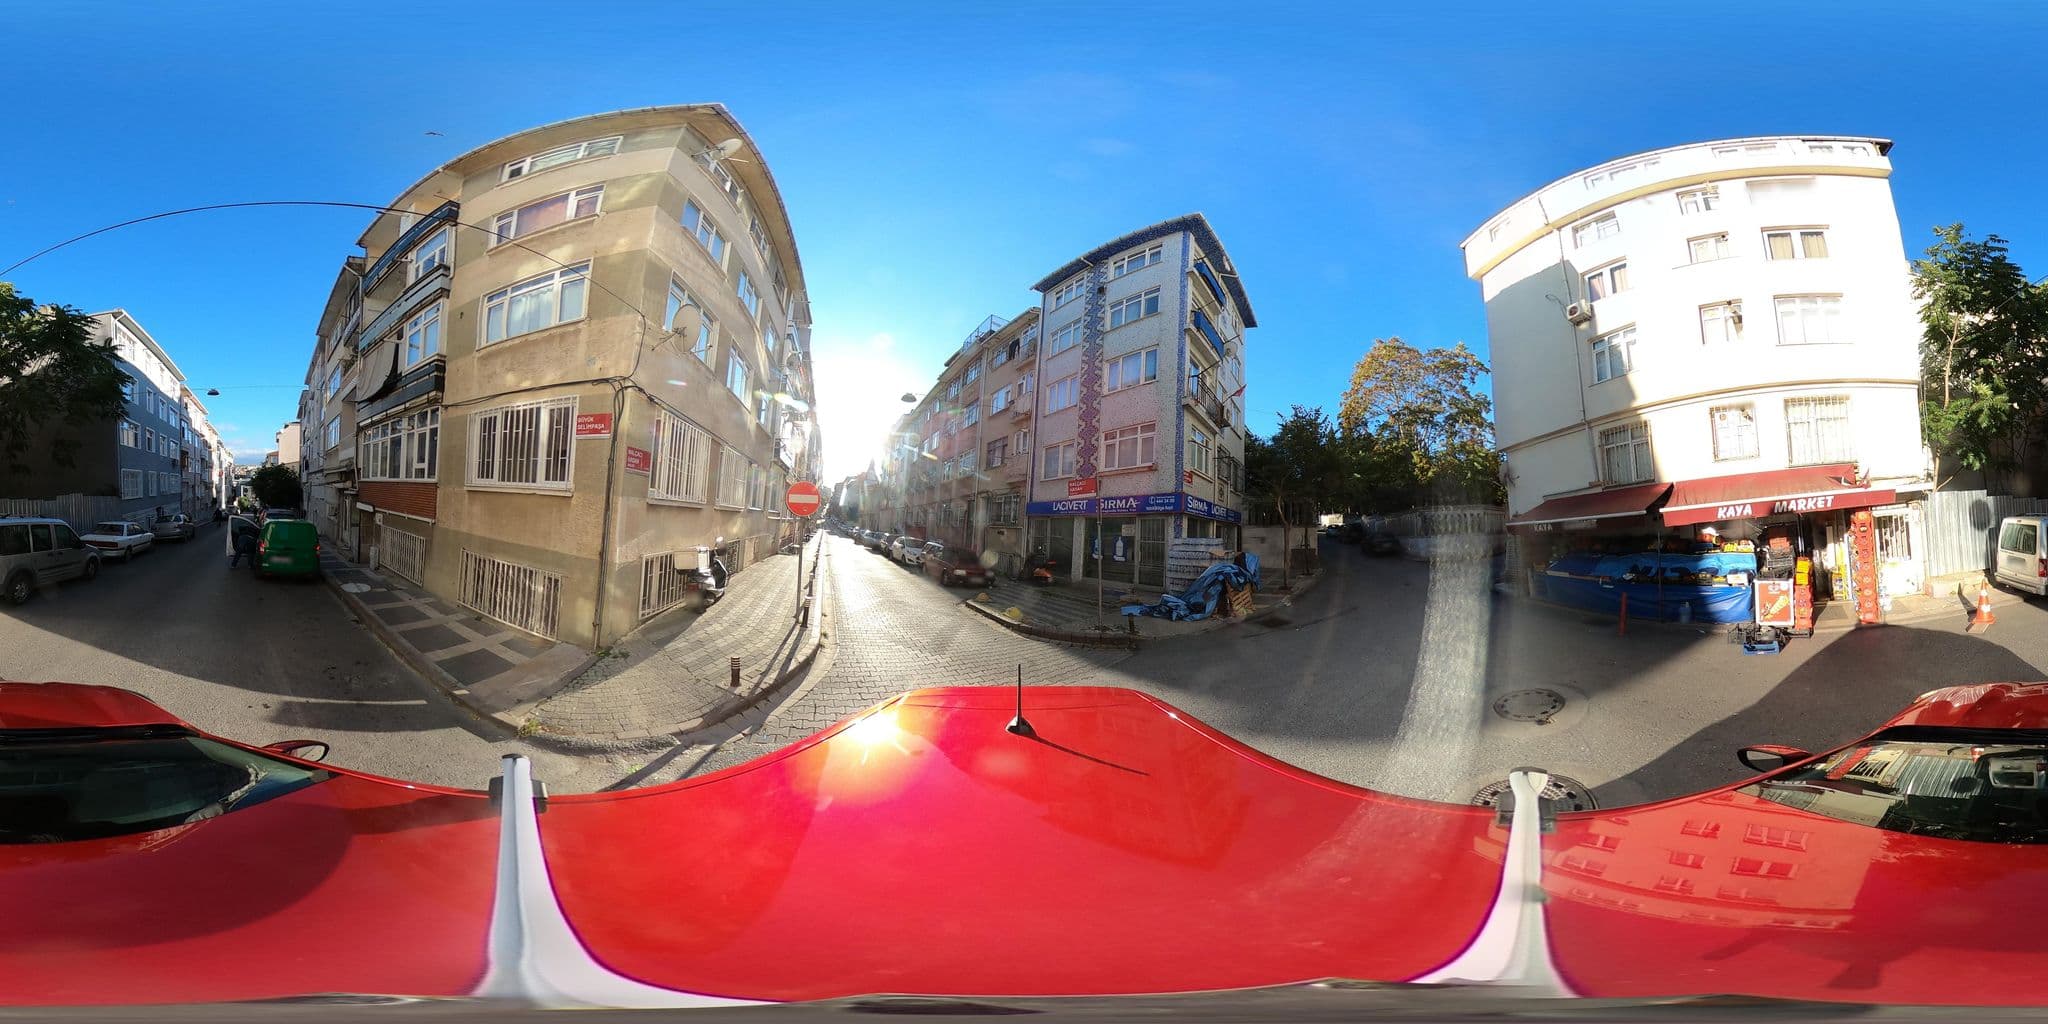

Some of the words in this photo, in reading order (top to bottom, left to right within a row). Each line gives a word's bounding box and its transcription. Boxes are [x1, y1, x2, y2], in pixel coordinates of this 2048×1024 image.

[1187, 496, 1208, 512] SIRMA
[1717, 504, 1752, 519] KAYA
[1774, 496, 1834, 513] MARKET
[1534, 523, 1552, 532] KAYA
